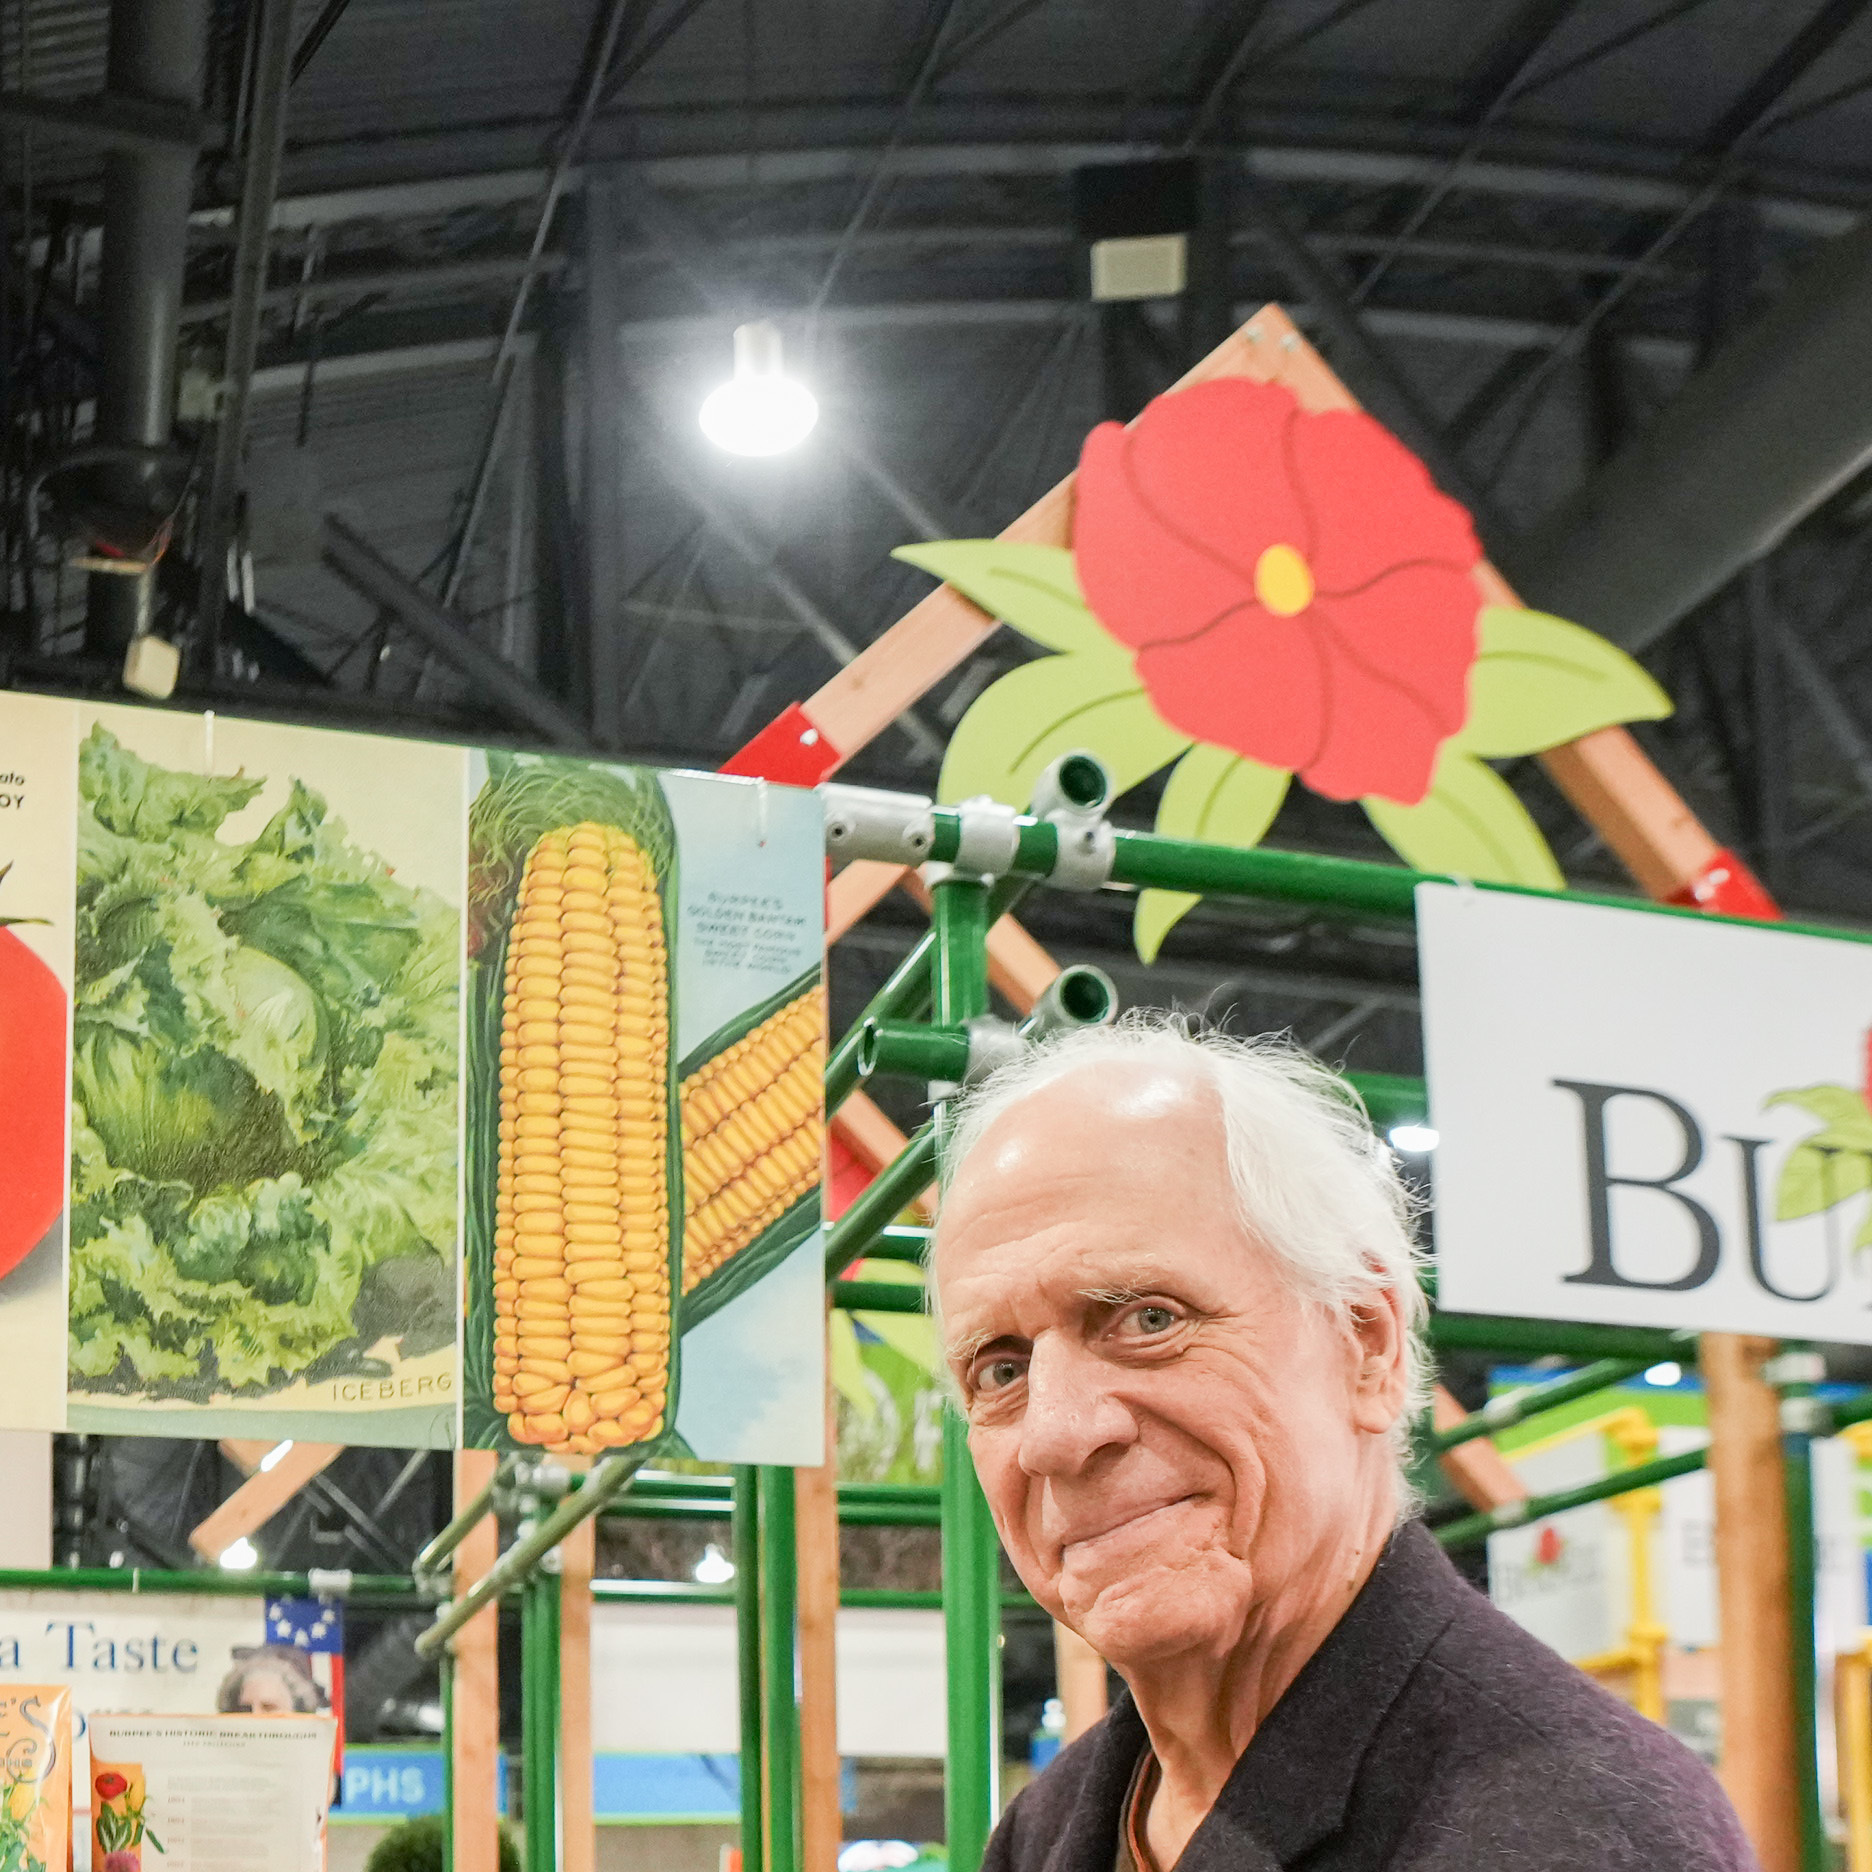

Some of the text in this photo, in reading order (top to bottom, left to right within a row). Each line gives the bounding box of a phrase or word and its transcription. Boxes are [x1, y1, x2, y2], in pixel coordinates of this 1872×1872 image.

[333, 1371, 452, 1402] ICEBERG
[45, 1619, 199, 1673] Taste
[346, 1766, 425, 1804] PHS
